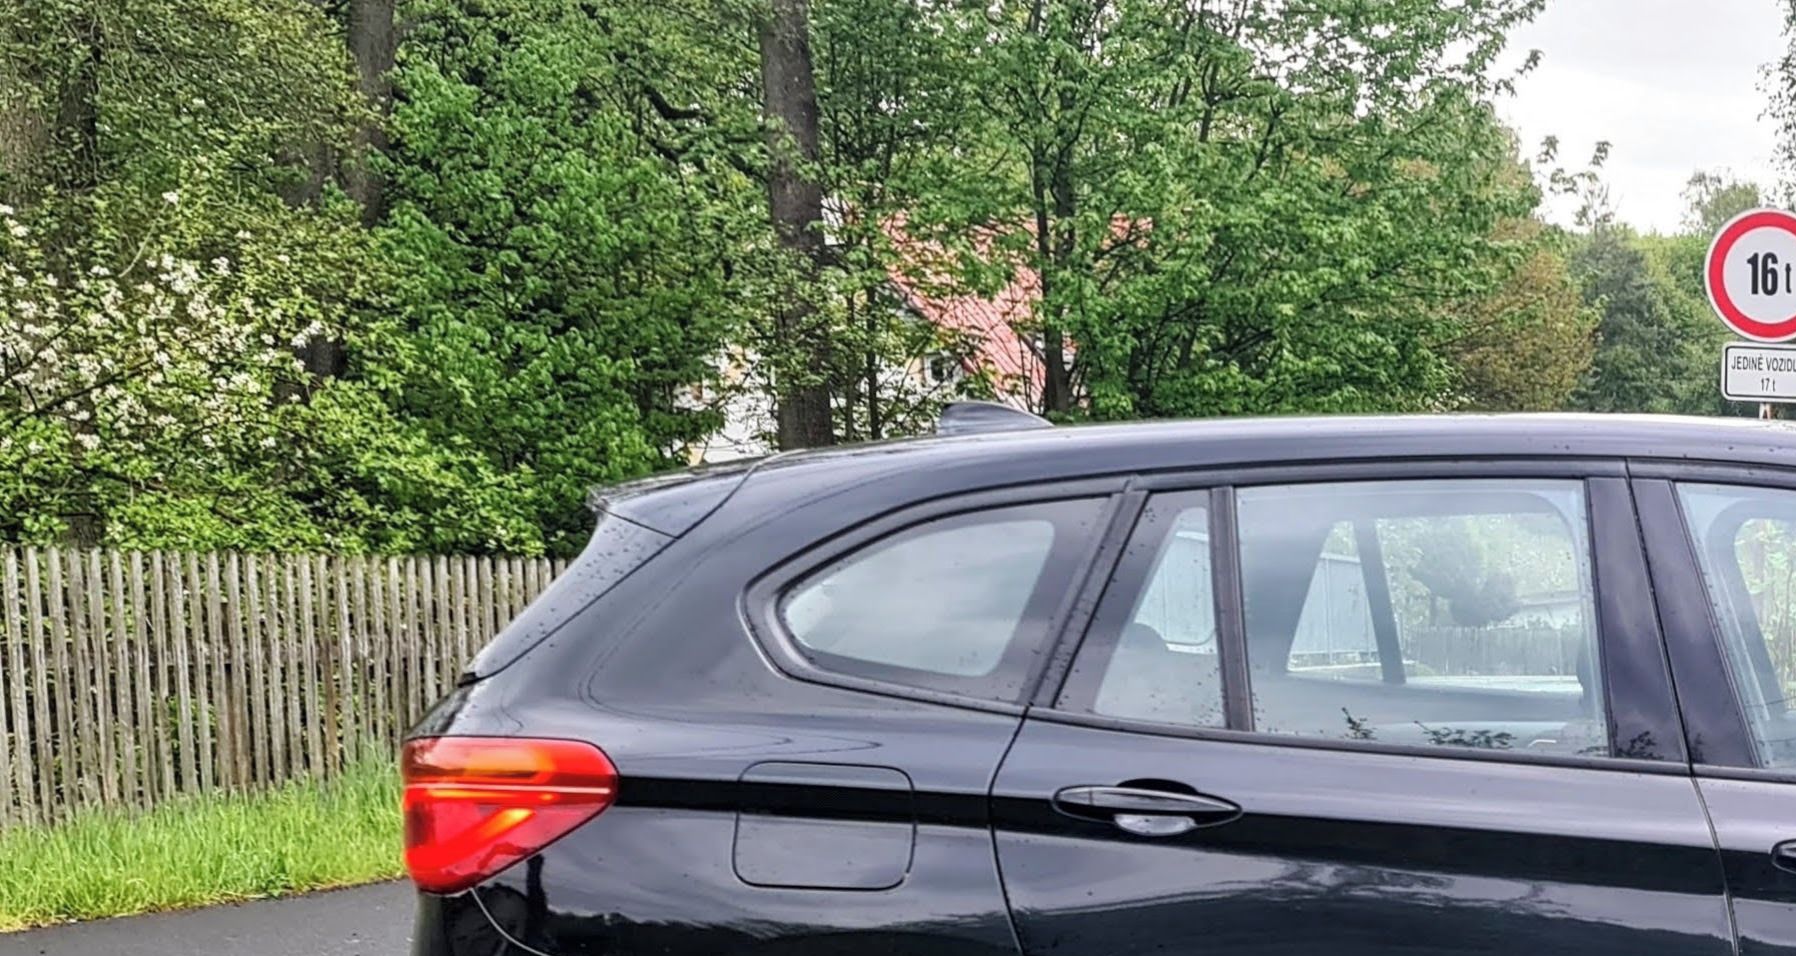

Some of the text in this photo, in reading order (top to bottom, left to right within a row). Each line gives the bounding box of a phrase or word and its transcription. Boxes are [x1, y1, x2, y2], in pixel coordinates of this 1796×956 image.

[1747, 252, 1792, 296] 16 t
[1760, 377, 1776, 392] 17 t
